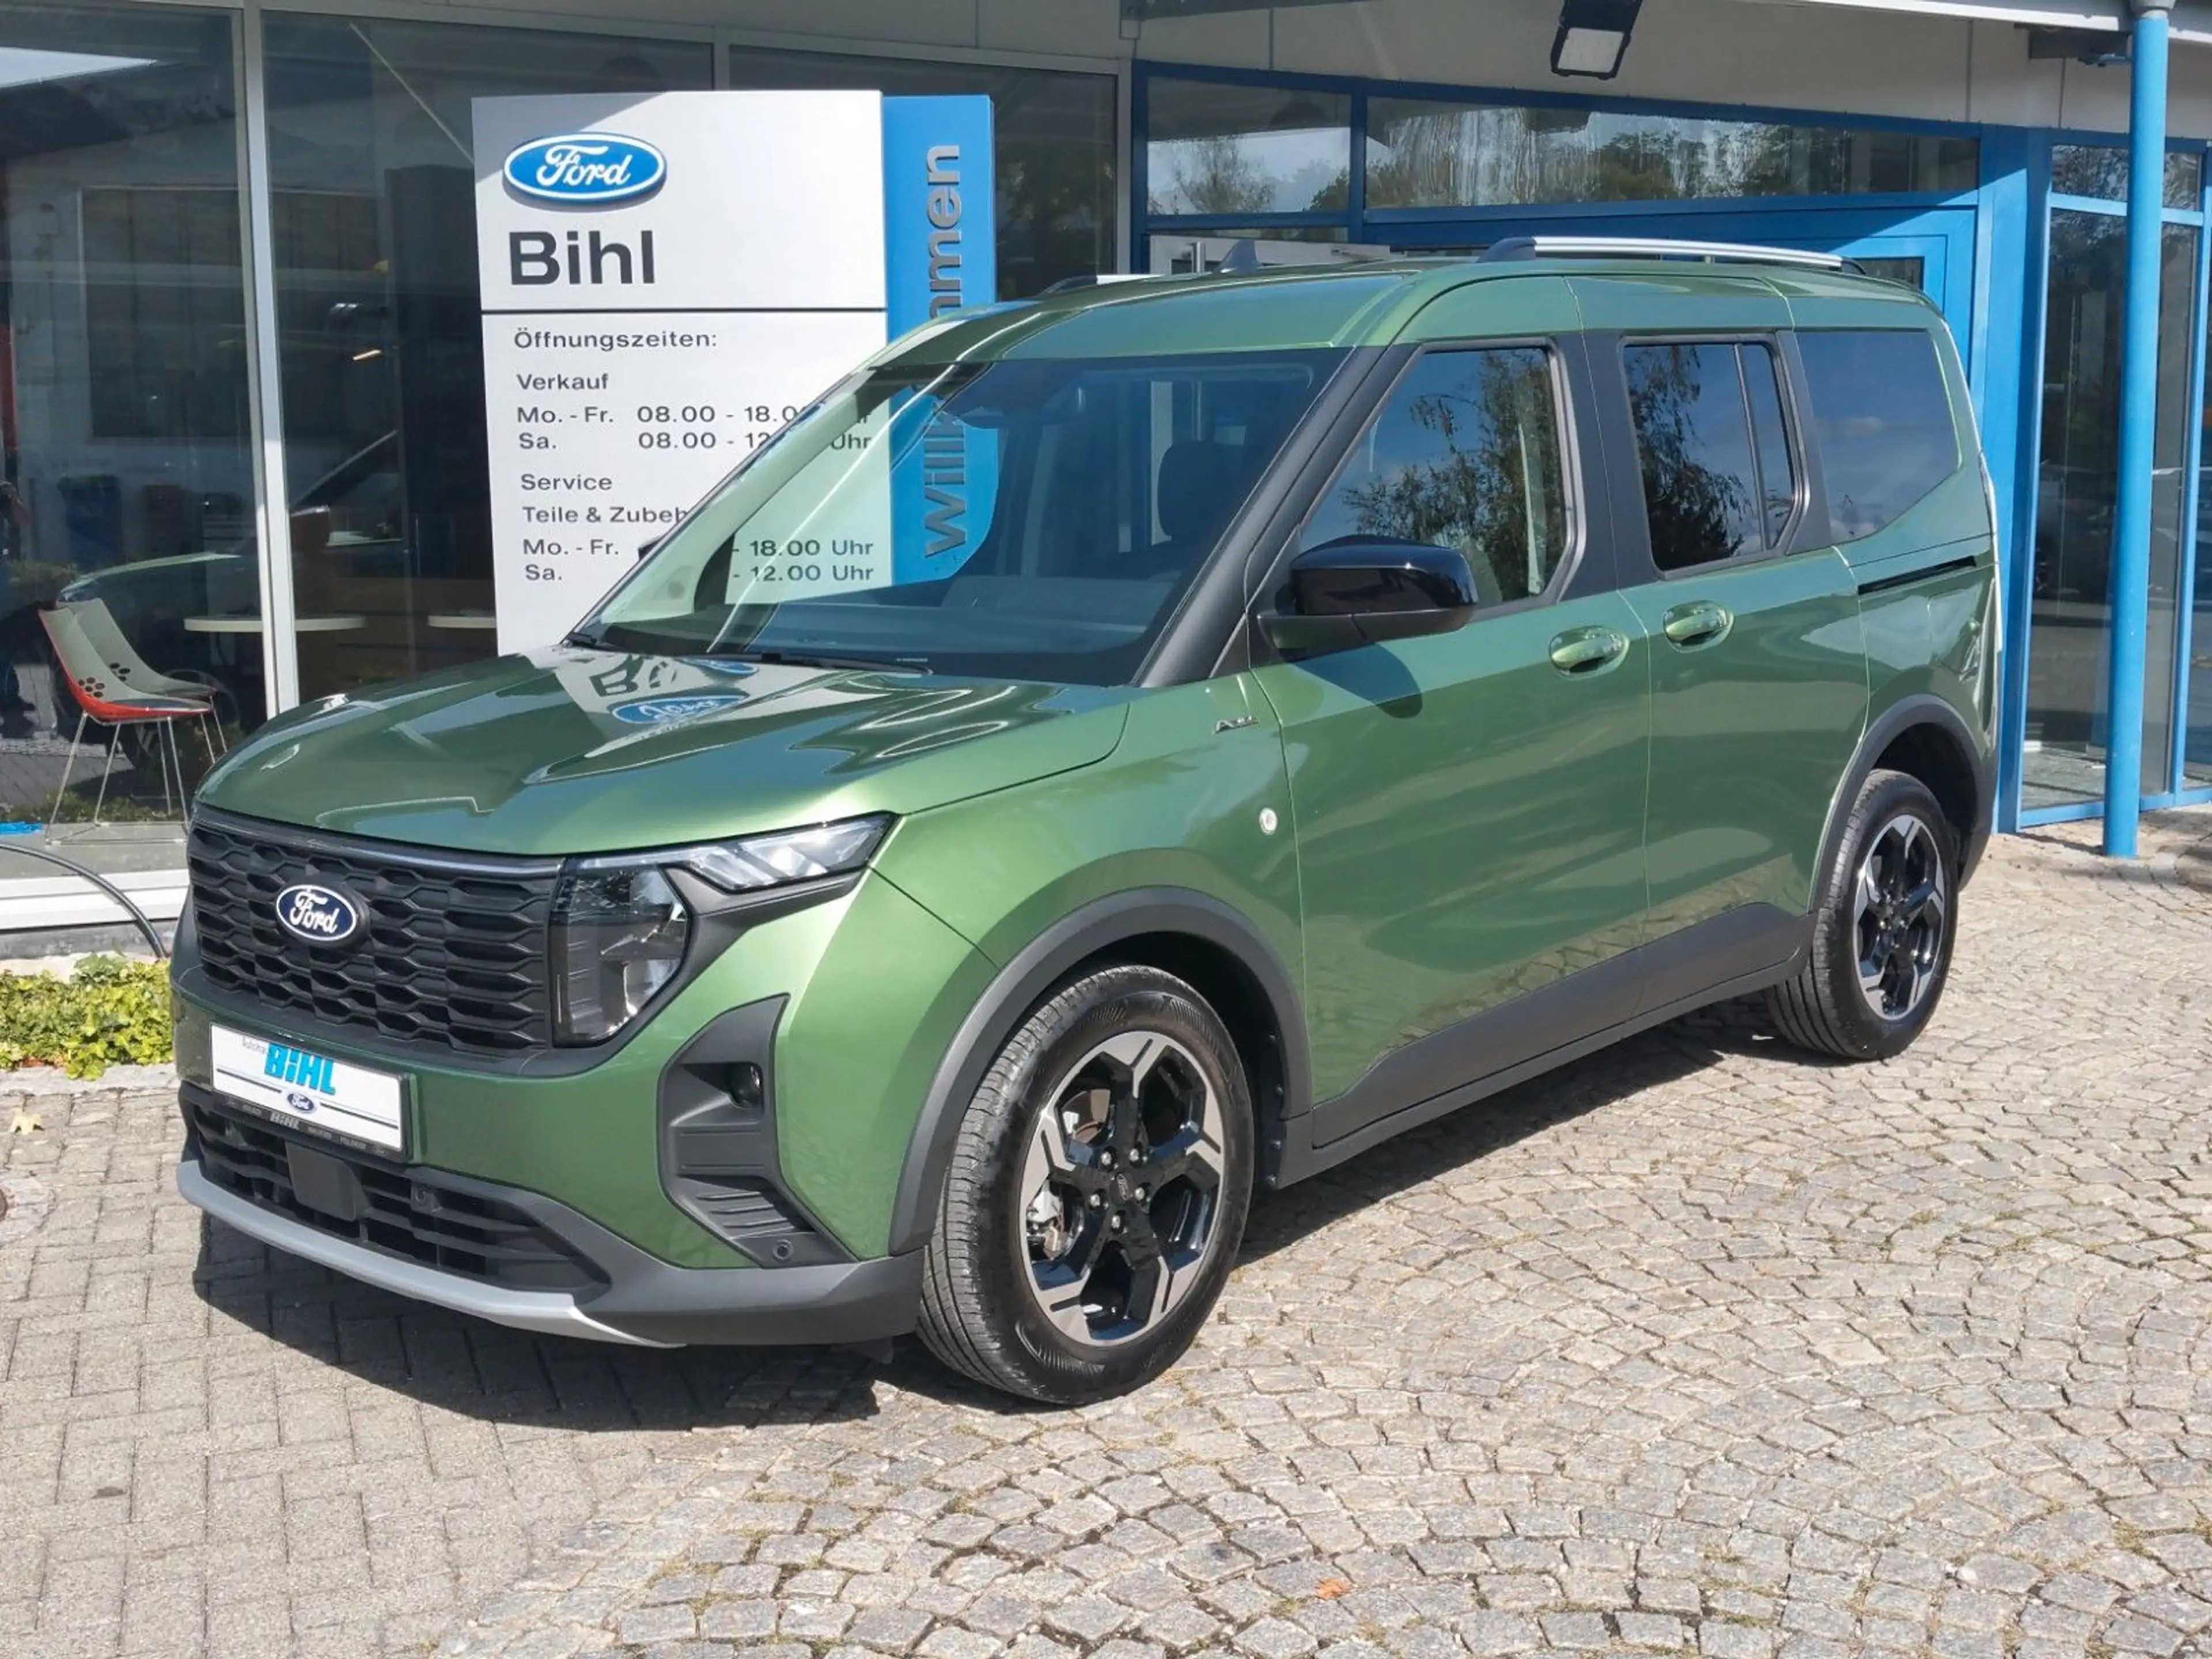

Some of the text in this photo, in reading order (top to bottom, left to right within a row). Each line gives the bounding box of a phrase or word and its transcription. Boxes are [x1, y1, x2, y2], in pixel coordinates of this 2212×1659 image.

[536, 145, 632, 186] Ford
[509, 230, 654, 285] Bihl
[514, 327, 717, 352] Öffnungszeiten:
[516, 373, 609, 390] Verkauf
[517, 407, 563, 422] Mo.
[584, 407, 614, 422] Fr.
[637, 406, 716, 422] 08.00
[744, 406, 807, 422] 18.0
[518, 432, 557, 449] Sa.
[638, 432, 717, 449] 08.00
[521, 474, 612, 490] Service
[522, 506, 687, 523] Teile & Zubeh
[523, 539, 569, 555] Mo.
[590, 539, 619, 555] Fr.
[750, 539, 821, 556] 18.00
[832, 539, 873, 556] Uhr
[525, 565, 563, 581] Sa.
[750, 565, 821, 582] 12.00
[832, 565, 874, 582] Uhr
[290, 891, 340, 934] Ford
